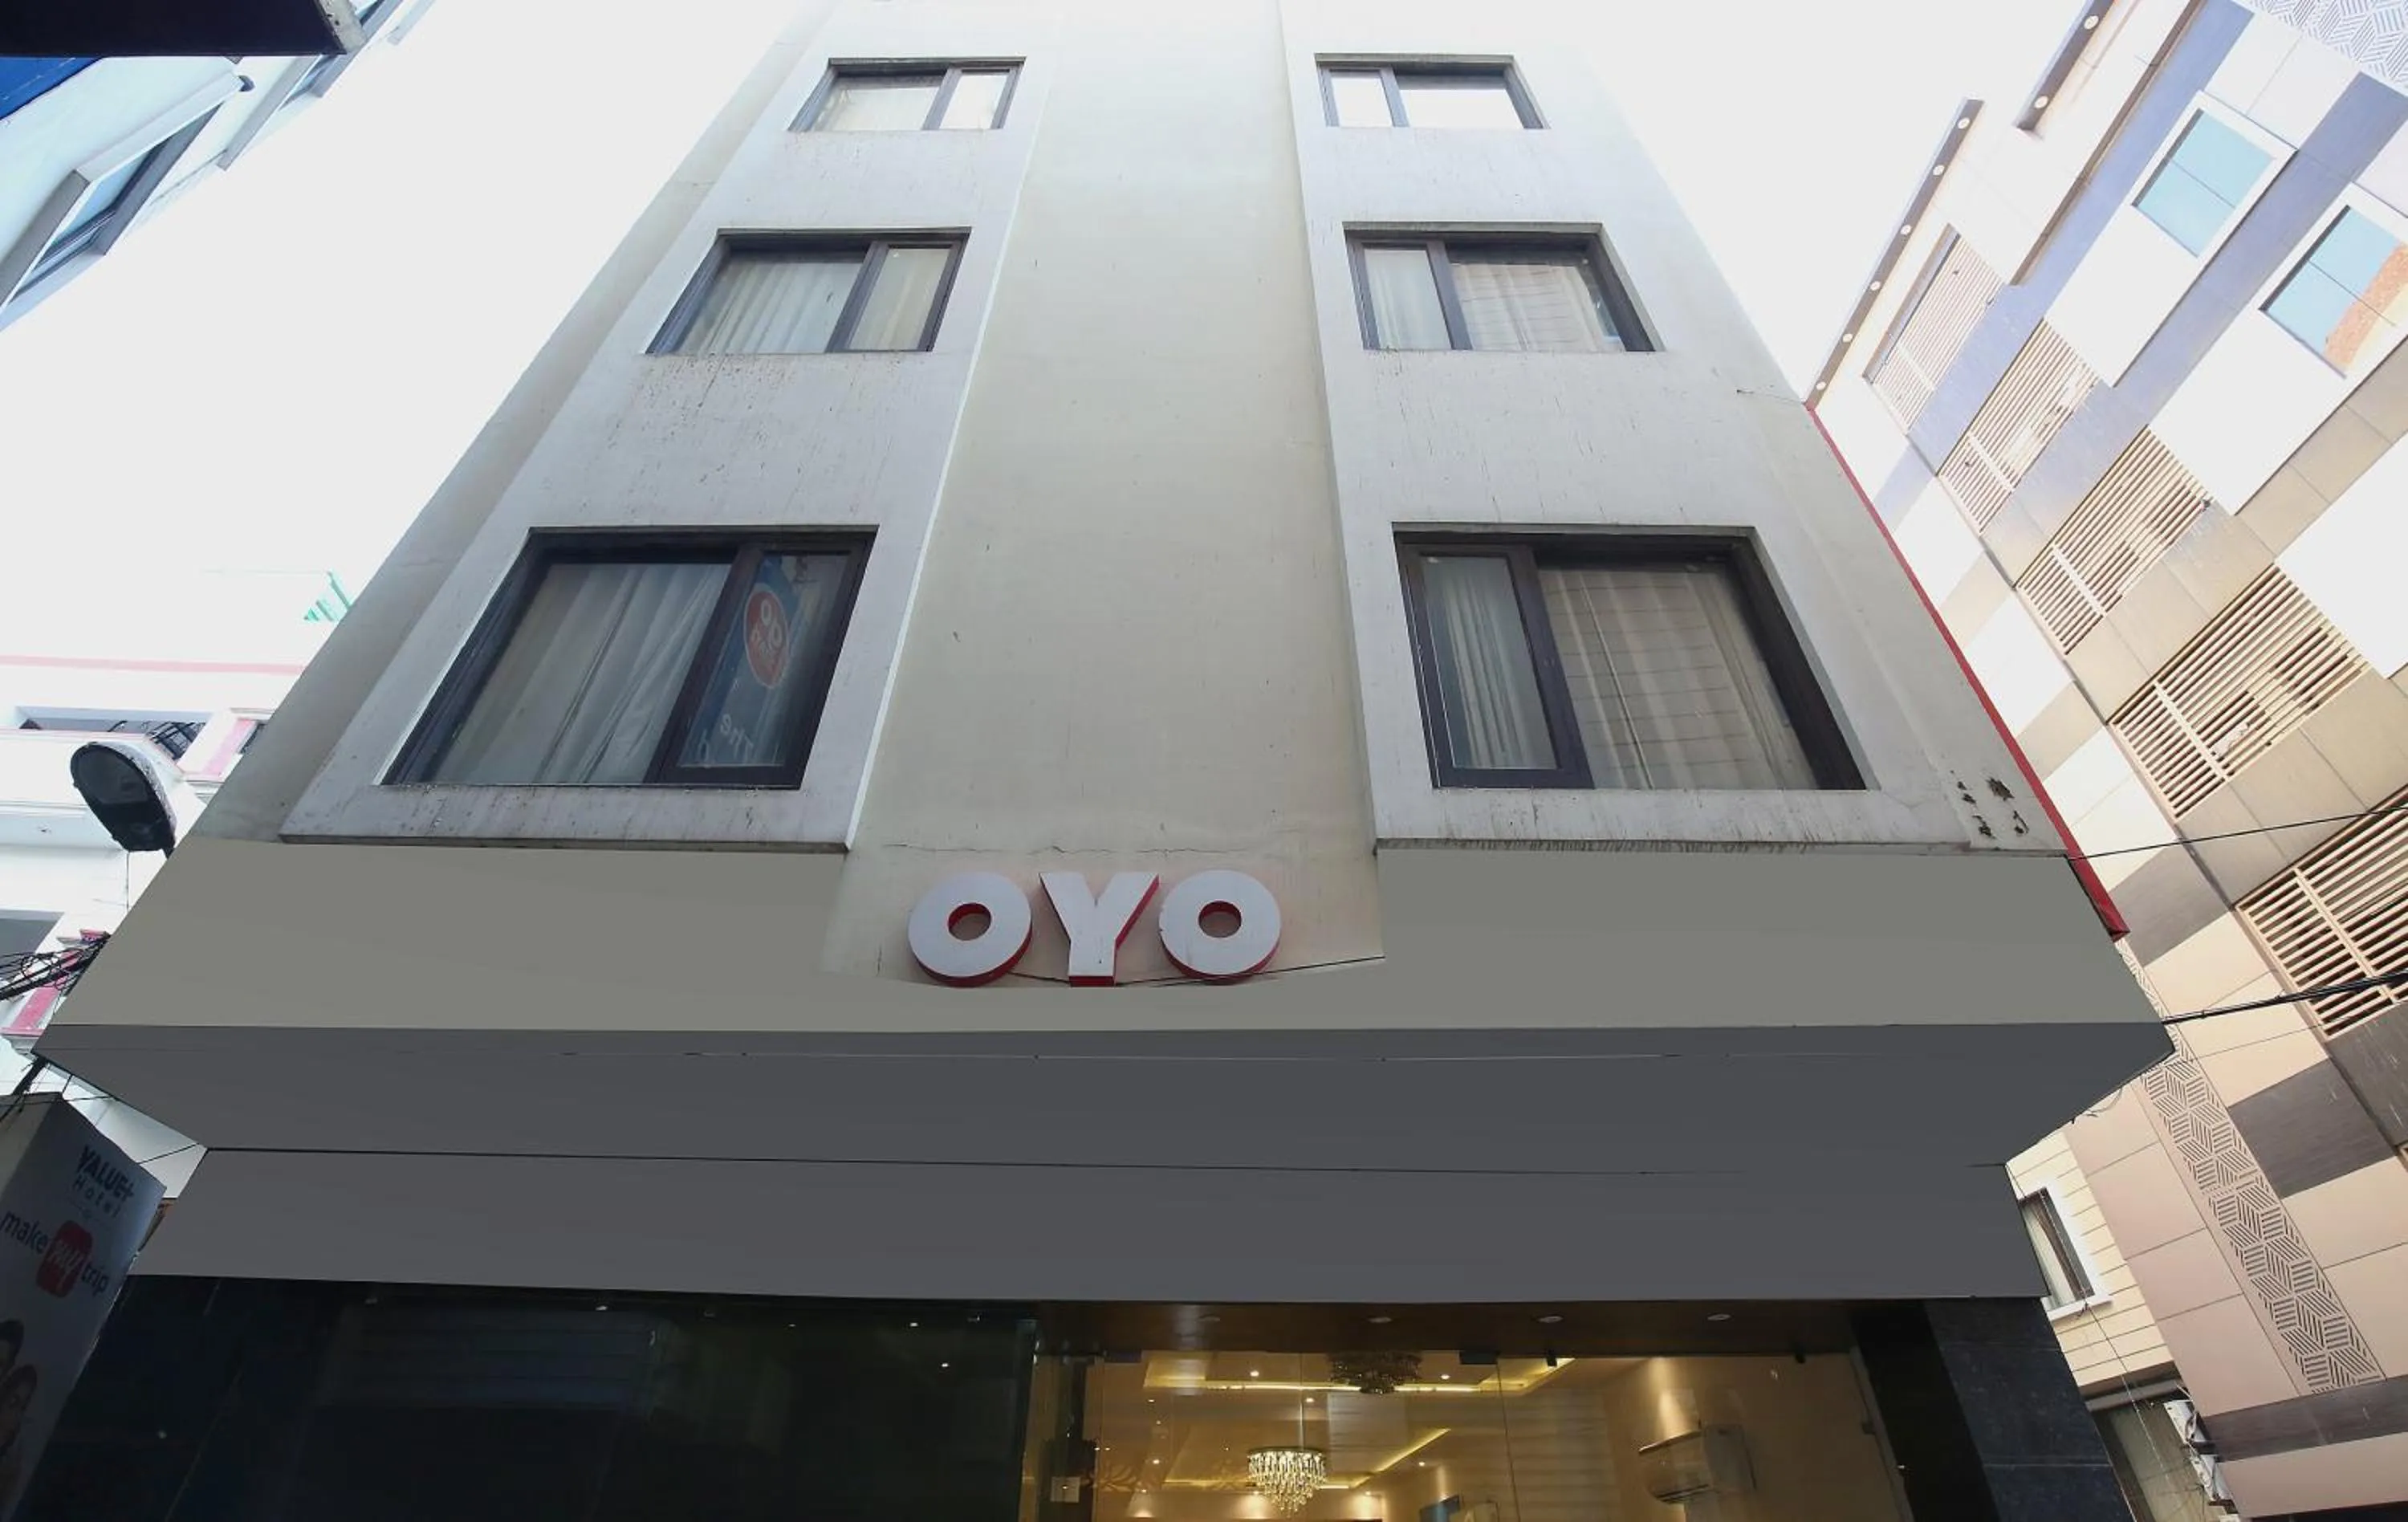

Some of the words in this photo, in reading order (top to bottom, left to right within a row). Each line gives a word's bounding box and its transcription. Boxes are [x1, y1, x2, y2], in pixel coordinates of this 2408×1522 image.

[908, 869, 1282, 987] OYO
[72, 1174, 121, 1217] Hotel
[0, 1211, 48, 1254] make
[80, 1262, 109, 1297] trip
